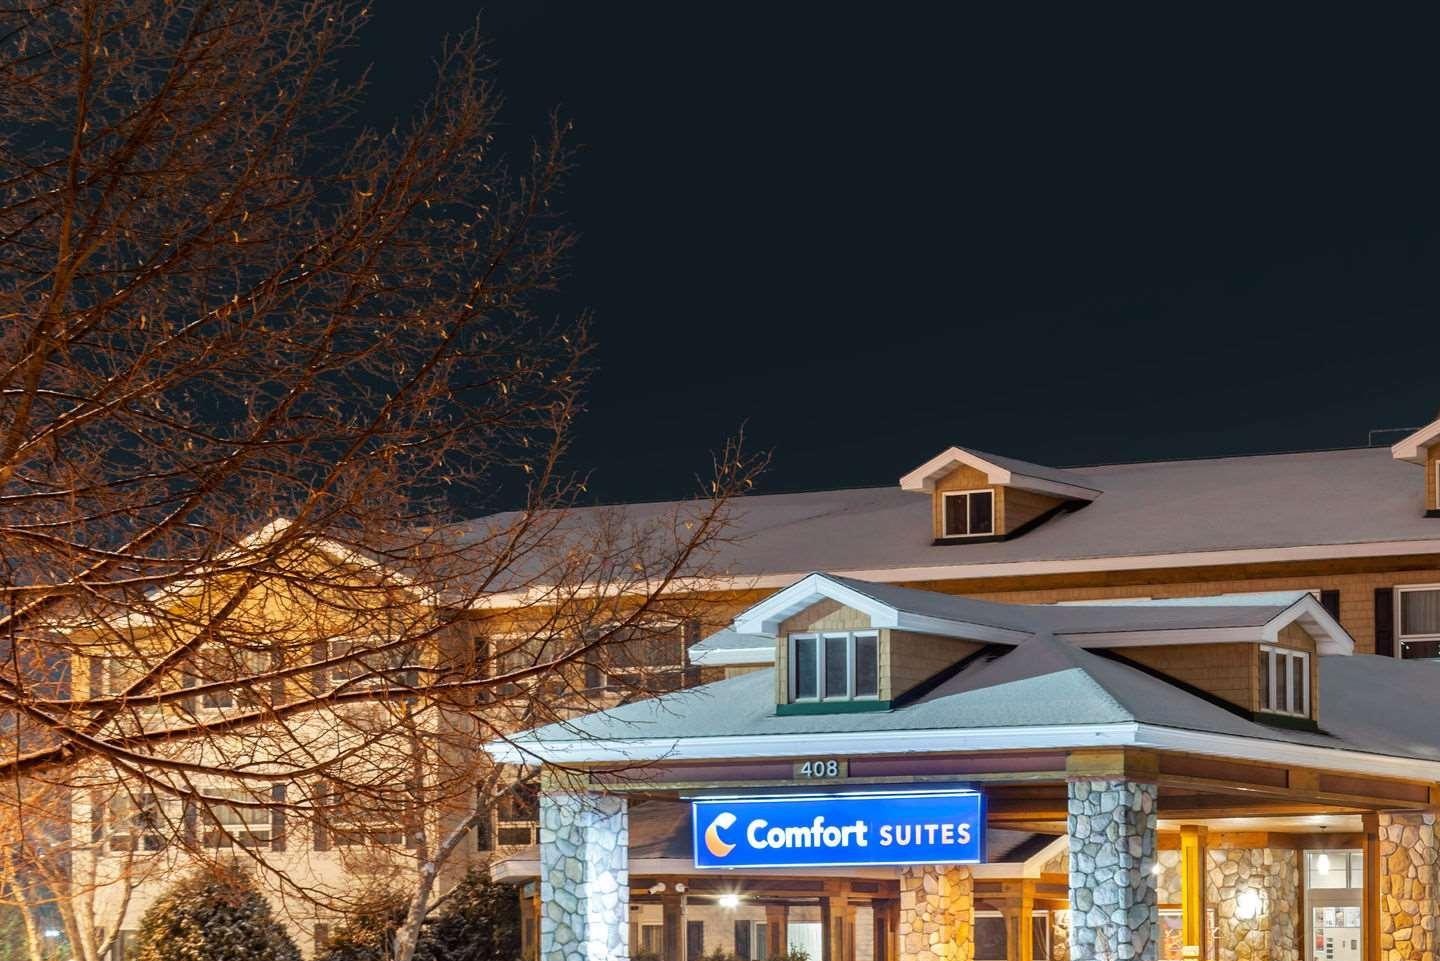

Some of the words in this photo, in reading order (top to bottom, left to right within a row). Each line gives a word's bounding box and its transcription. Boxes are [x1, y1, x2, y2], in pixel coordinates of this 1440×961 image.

[800, 760, 838, 777] 408
[746, 815, 868, 848] Comfort
[879, 823, 972, 847] SUITES
